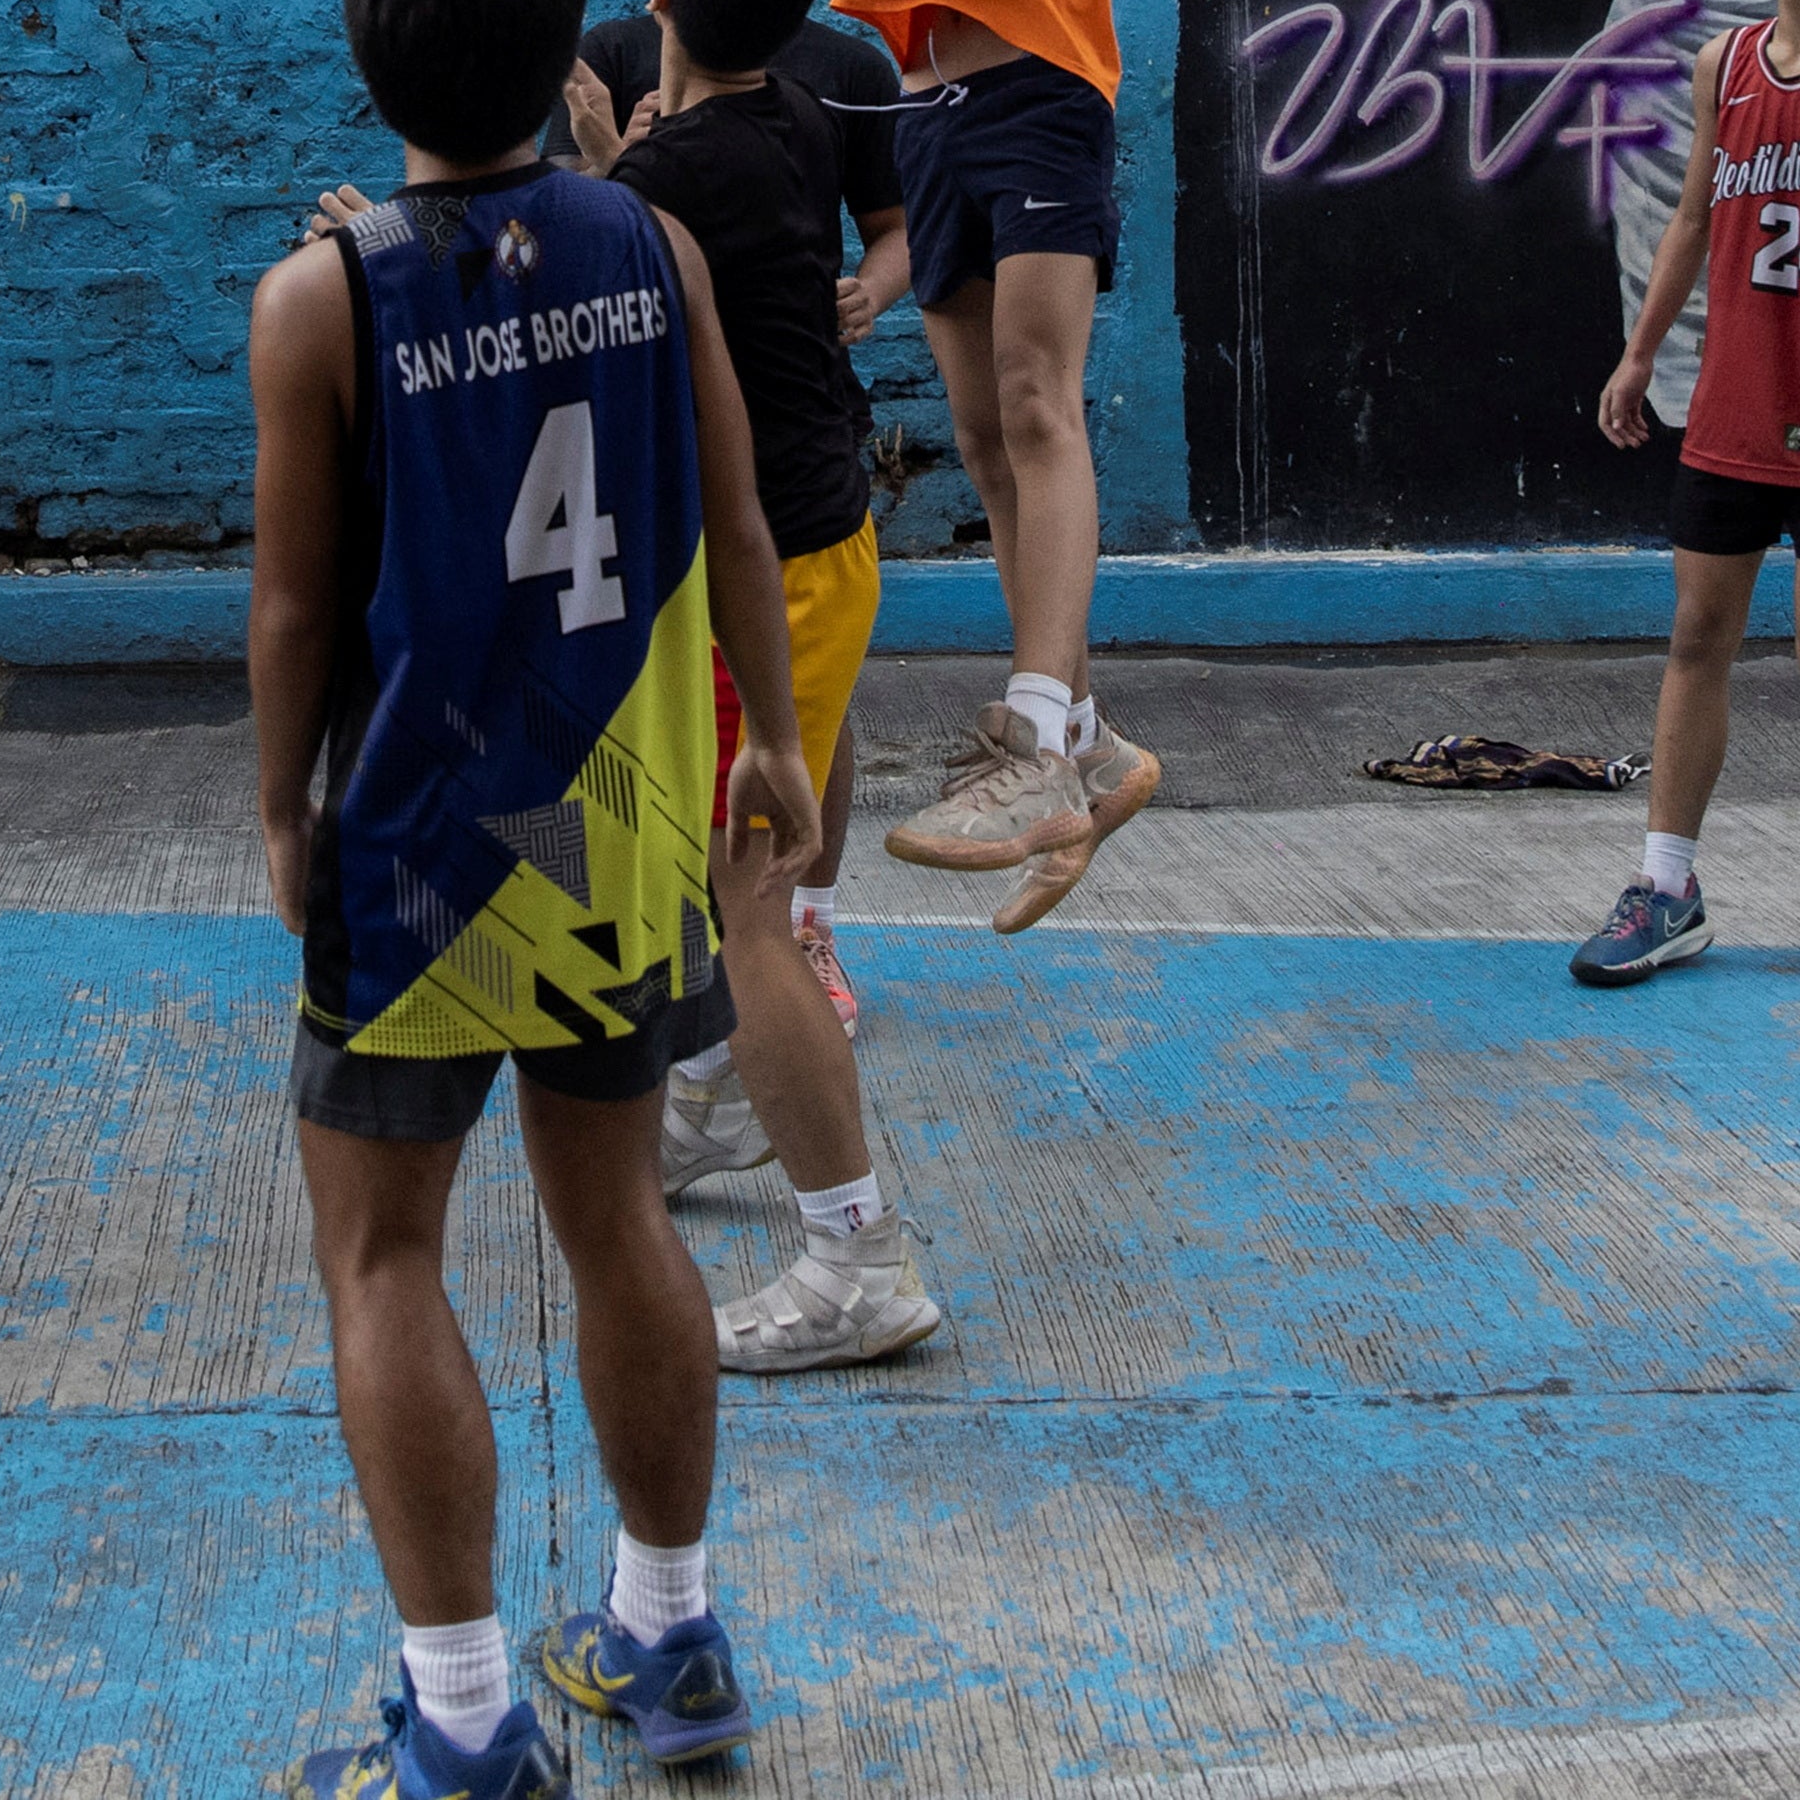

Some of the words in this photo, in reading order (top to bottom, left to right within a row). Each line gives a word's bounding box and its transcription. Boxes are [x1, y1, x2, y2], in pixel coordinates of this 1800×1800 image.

[396, 333, 456, 395] SAN
[464, 317, 527, 382] JOSE
[530, 286, 667, 365] BROTHERS
[505, 400, 626, 634] 4
